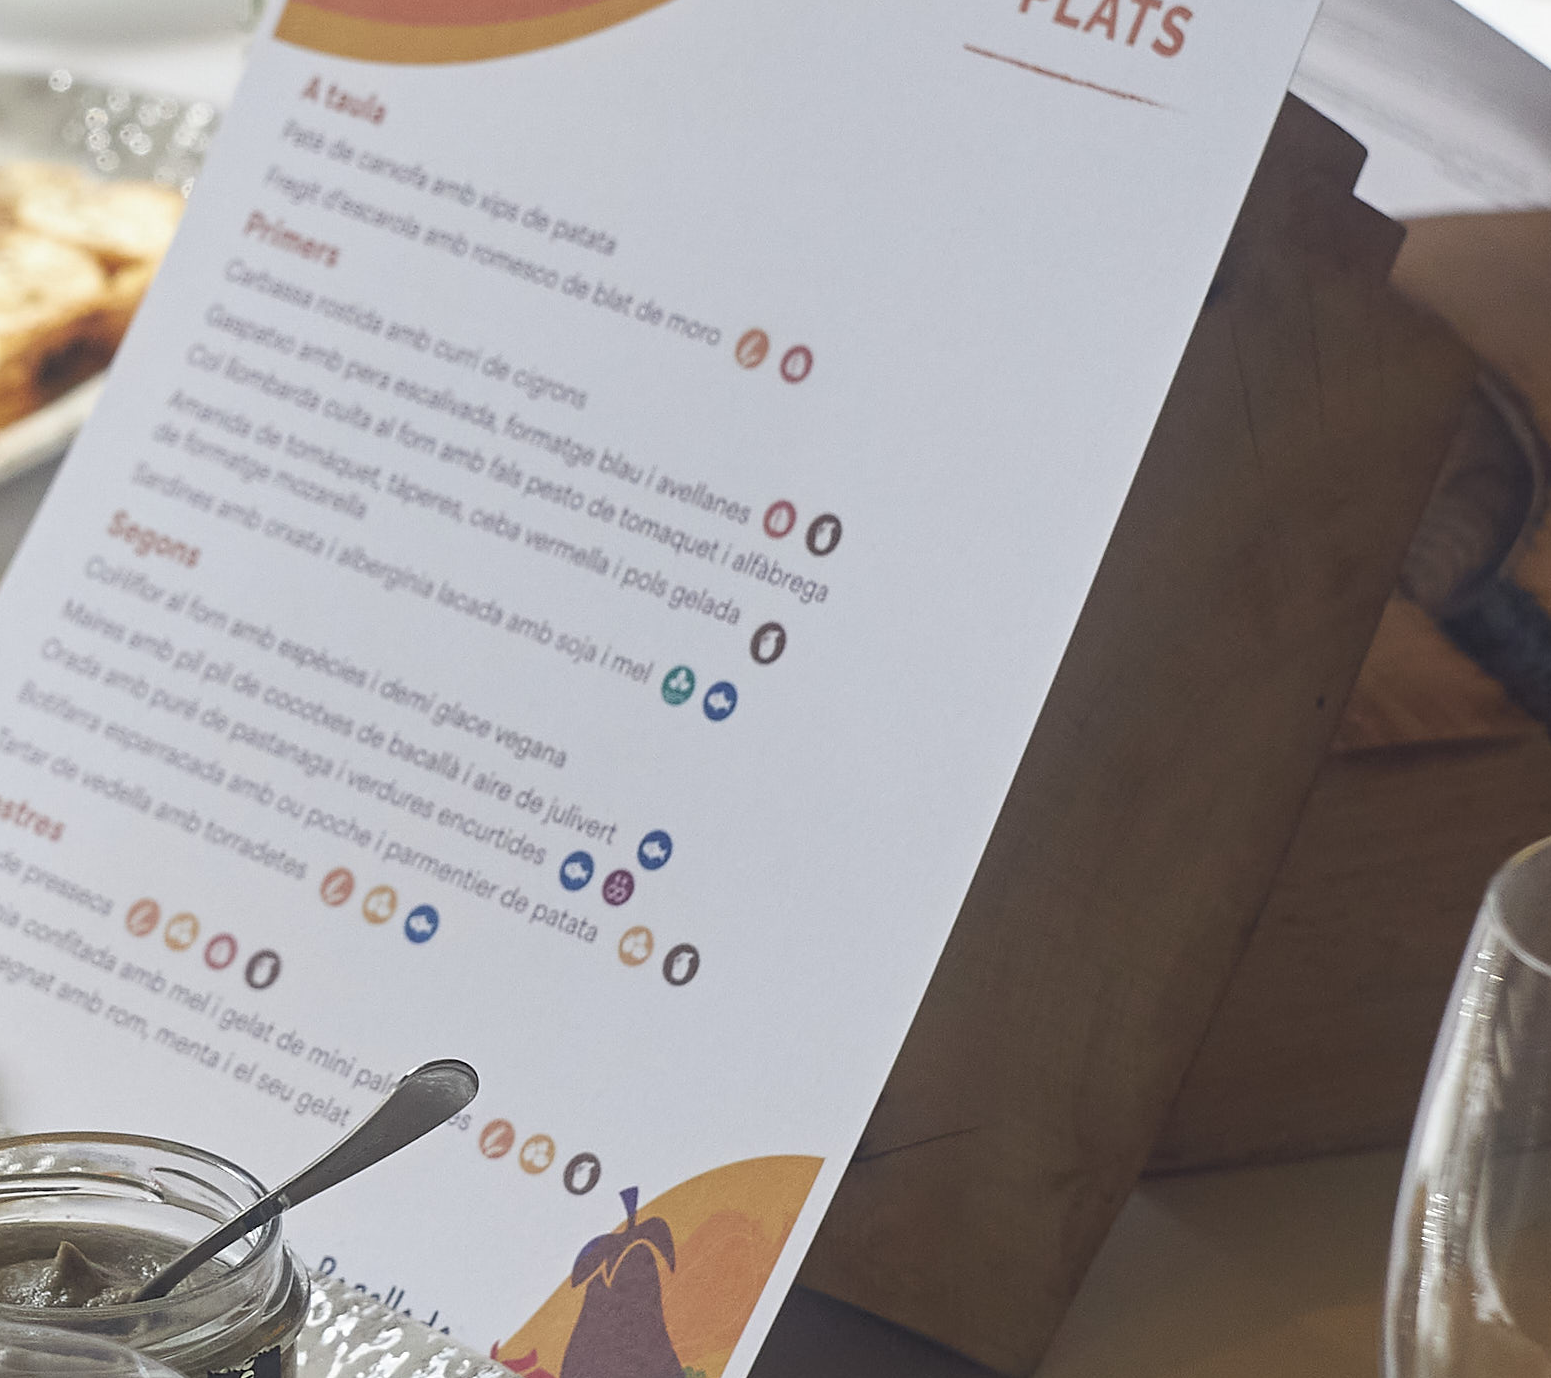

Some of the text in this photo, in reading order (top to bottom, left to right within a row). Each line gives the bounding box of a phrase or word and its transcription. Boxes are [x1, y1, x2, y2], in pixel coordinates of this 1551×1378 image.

[323, 83, 387, 126] taula
[241, 208, 341, 269] Primers
[325, 138, 356, 164] de
[428, 176, 477, 207] amb
[519, 205, 552, 234] de
[548, 217, 618, 257] patata
[421, 226, 470, 258] amb
[559, 271, 592, 301] de
[590, 279, 635, 317] blat
[633, 298, 665, 327] de
[664, 311, 723, 347] moro
[383, 320, 433, 353] amb
[480, 353, 512, 382] de
[511, 367, 589, 411] cigrons
[151, 421, 182, 448] de
[181, 428, 272, 484] formatge
[296, 342, 344, 373] amb
[341, 359, 392, 391] pera
[502, 411, 597, 468] formatge
[596, 447, 645, 486] blau
[653, 473, 753, 526] avellanes
[105, 508, 202, 569] Segons
[253, 424, 283, 449] de
[523, 528, 611, 576] vermella
[618, 565, 669, 599] pols
[666, 583, 742, 626] gelada
[372, 416, 397, 438] al
[395, 420, 438, 455] forn
[437, 441, 486, 474] amb
[521, 474, 586, 512] pesto
[585, 495, 617, 524] de
[617, 505, 721, 563] tomaquet
[729, 550, 830, 606] alfàbrega
[215, 499, 262, 531] amb
[503, 612, 554, 646] amb
[608, 653, 656, 685] mel
[126, 630, 175, 662] amb
[231, 671, 262, 699] de
[355, 722, 386, 750] de
[470, 770, 514, 802] aire
[513, 785, 545, 815] de
[539, 795, 619, 847] julivert
[164, 592, 188, 612] al
[186, 595, 229, 630] forn
[227, 618, 277, 651] amb
[429, 700, 493, 739] glace
[493, 724, 568, 770] vegana
[48, 755, 80, 781] de
[151, 800, 203, 835] amb
[101, 668, 150, 700] amb
[198, 706, 230, 733] de
[226, 720, 335, 778] pastanaga
[345, 769, 436, 820] verdures
[435, 806, 548, 867] encurtides
[225, 773, 275, 807] amb
[274, 794, 305, 820] ou
[380, 840, 501, 900] parmentier
[497, 885, 530, 915] de
[526, 901, 599, 945] patata
[54, 981, 105, 1016] amb
[152, 1025, 222, 1070] menta
[231, 1061, 259, 1084] el
[254, 1071, 296, 1103] seu
[292, 1090, 352, 1129] gelat
[117, 960, 167, 995] amb
[166, 982, 213, 1014] mel
[216, 1006, 276, 1044] gelat
[274, 1028, 306, 1058] de
[305, 1045, 358, 1079] mini
